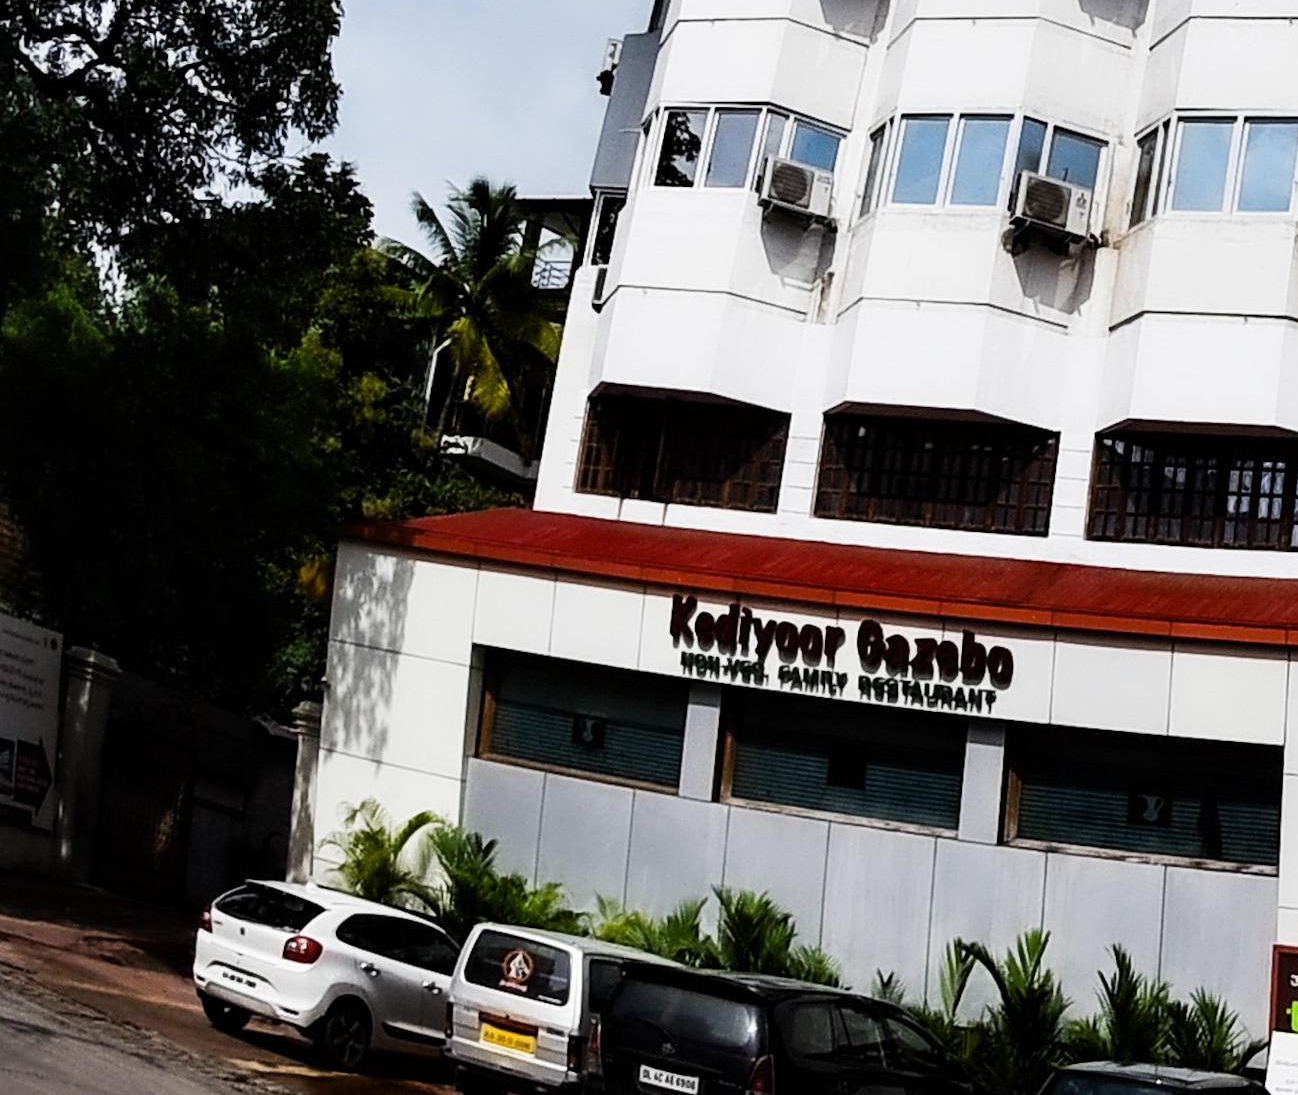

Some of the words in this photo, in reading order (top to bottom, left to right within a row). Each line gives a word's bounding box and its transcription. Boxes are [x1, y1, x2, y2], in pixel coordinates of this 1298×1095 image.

[669, 593, 846, 669] Kediyoor
[857, 619, 1014, 691] Gazebo
[777, 663, 849, 699] FAMILY
[858, 674, 998, 715] RESTAURANT
